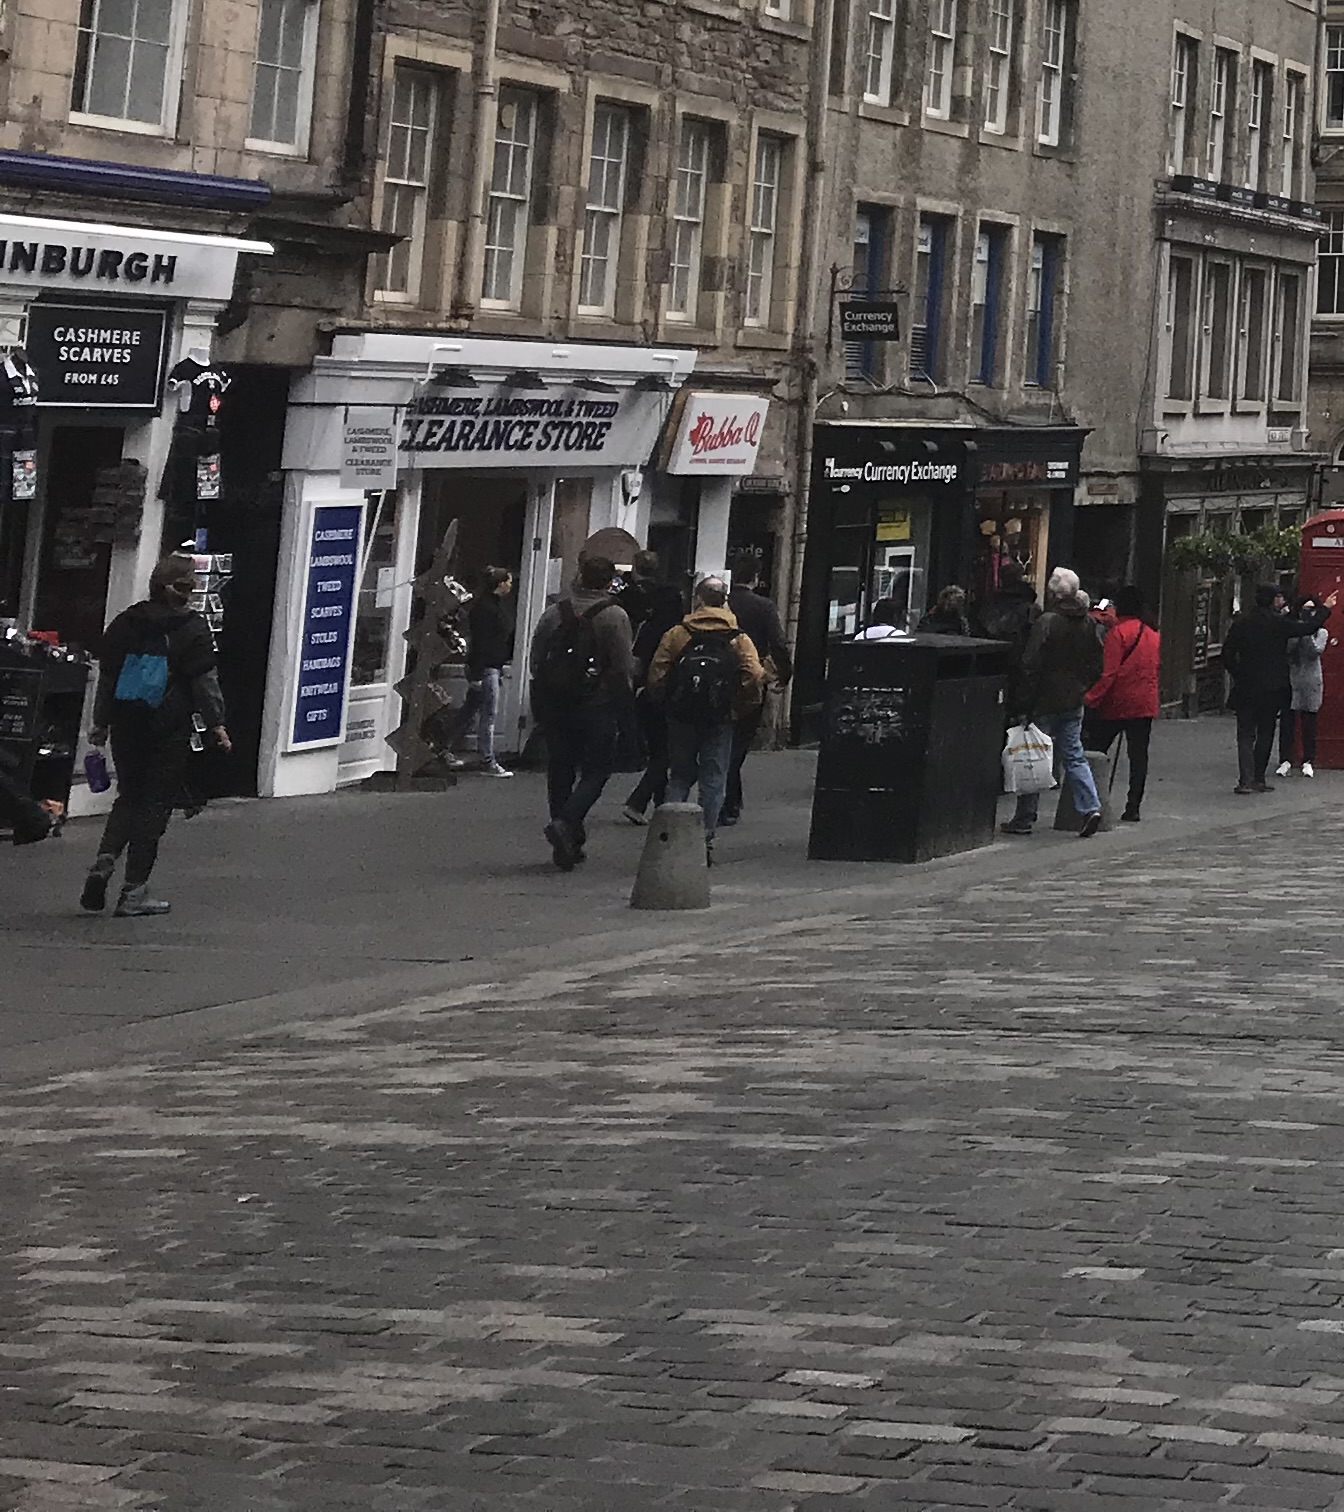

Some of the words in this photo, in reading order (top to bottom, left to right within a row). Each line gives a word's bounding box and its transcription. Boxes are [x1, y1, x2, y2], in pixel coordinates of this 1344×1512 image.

[844, 311, 892, 322] Currency
[843, 322, 895, 333] Exchange
[54, 327, 141, 345] CASHMERE
[59, 346, 132, 363] SCARVES
[64, 372, 97, 385] FROM
[100, 373, 119, 385] £45
[482, 398, 560, 418] LAMBSWOOL
[575, 400, 619, 418] TWEED
[536, 420, 612, 452] STORE
[692, 415, 742, 455] Bubba
[865, 462, 910, 484] Currency
[911, 461, 957, 484] Exchange
[315, 529, 354, 541] CASHMERE
[311, 554, 353, 567] LAMBSWOOL
[317, 580, 342, 592] TWEED
[311, 606, 343, 618] SCARVES
[311, 631, 338, 644] STOLES
[303, 656, 341, 670] HANDBAGS
[300, 682, 338, 698] KNITWEAR
[306, 709, 328, 722] GIFTS
